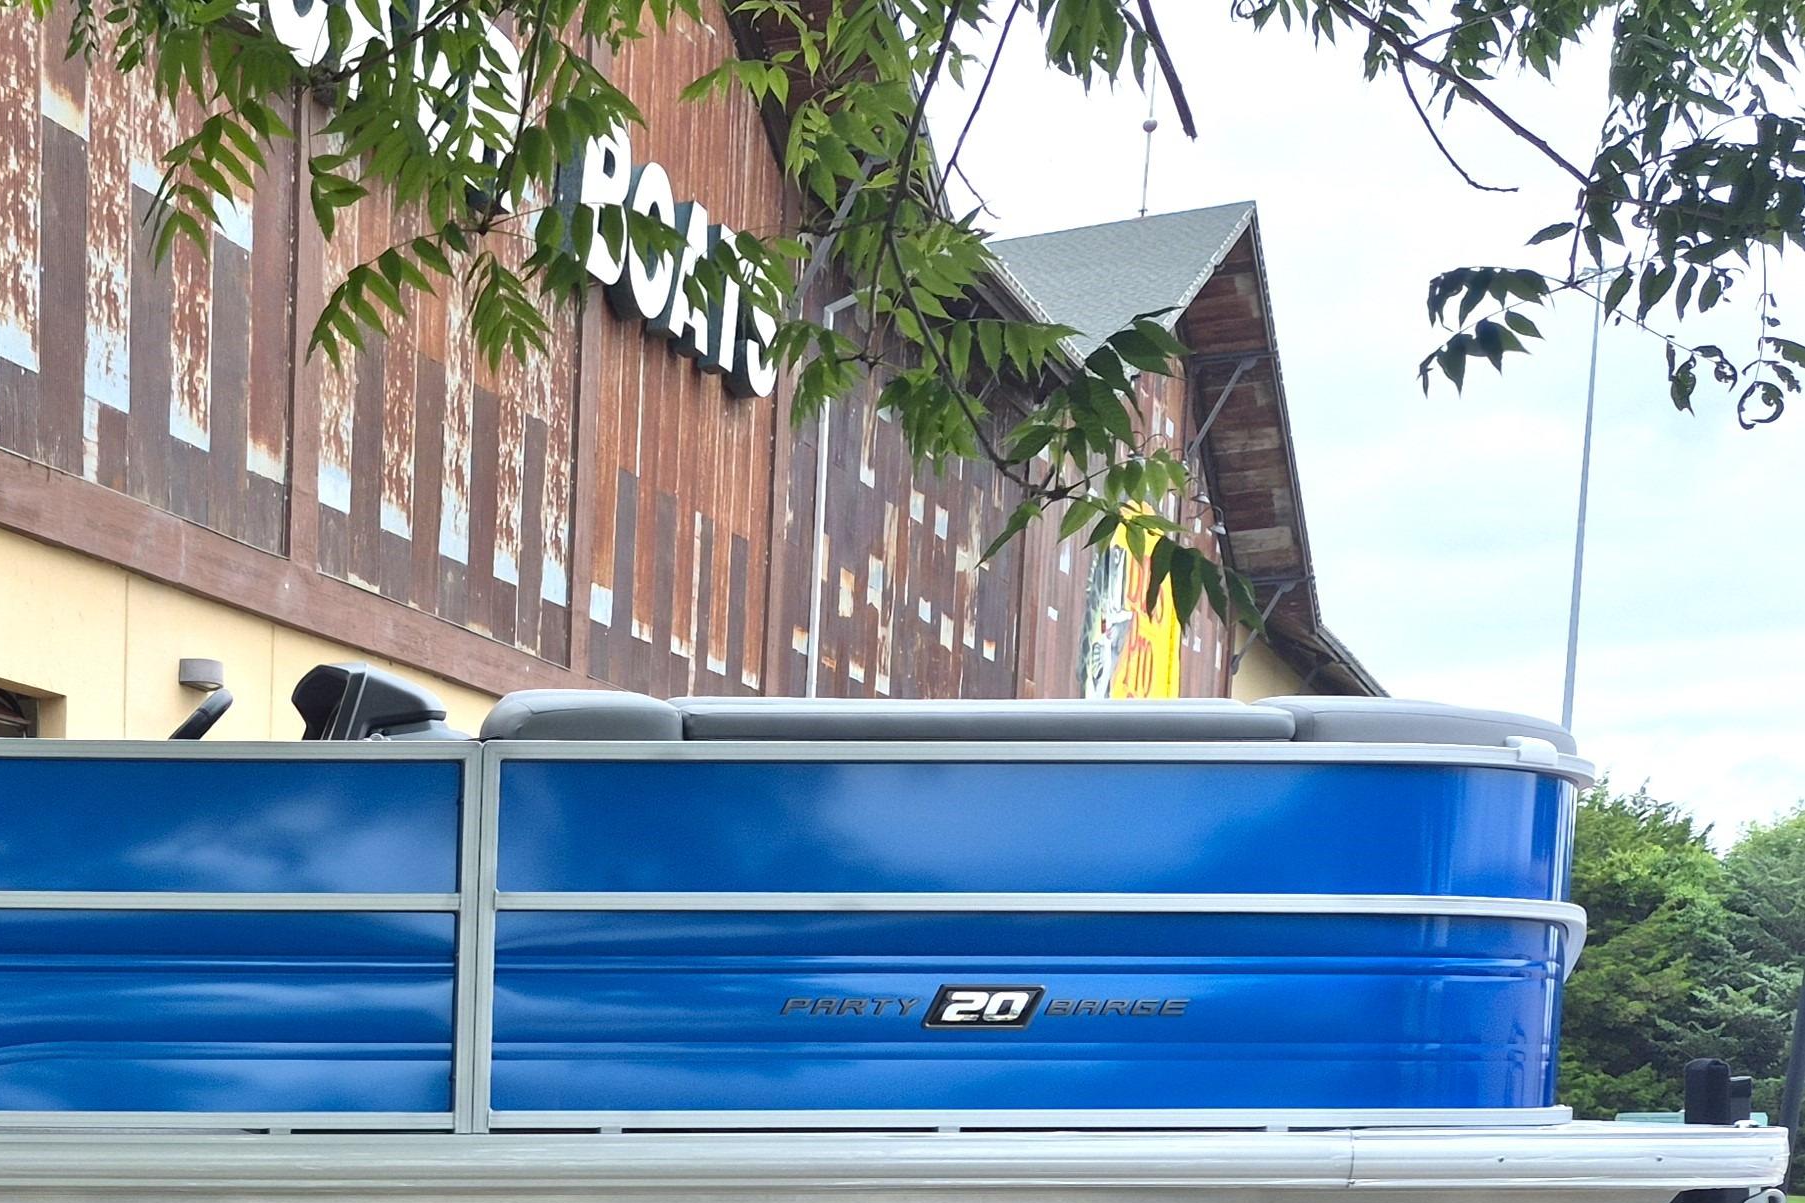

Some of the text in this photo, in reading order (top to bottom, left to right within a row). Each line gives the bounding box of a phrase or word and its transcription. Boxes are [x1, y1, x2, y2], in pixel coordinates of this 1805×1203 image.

[779, 991, 1191, 1022] PARTY 20 BARGE
